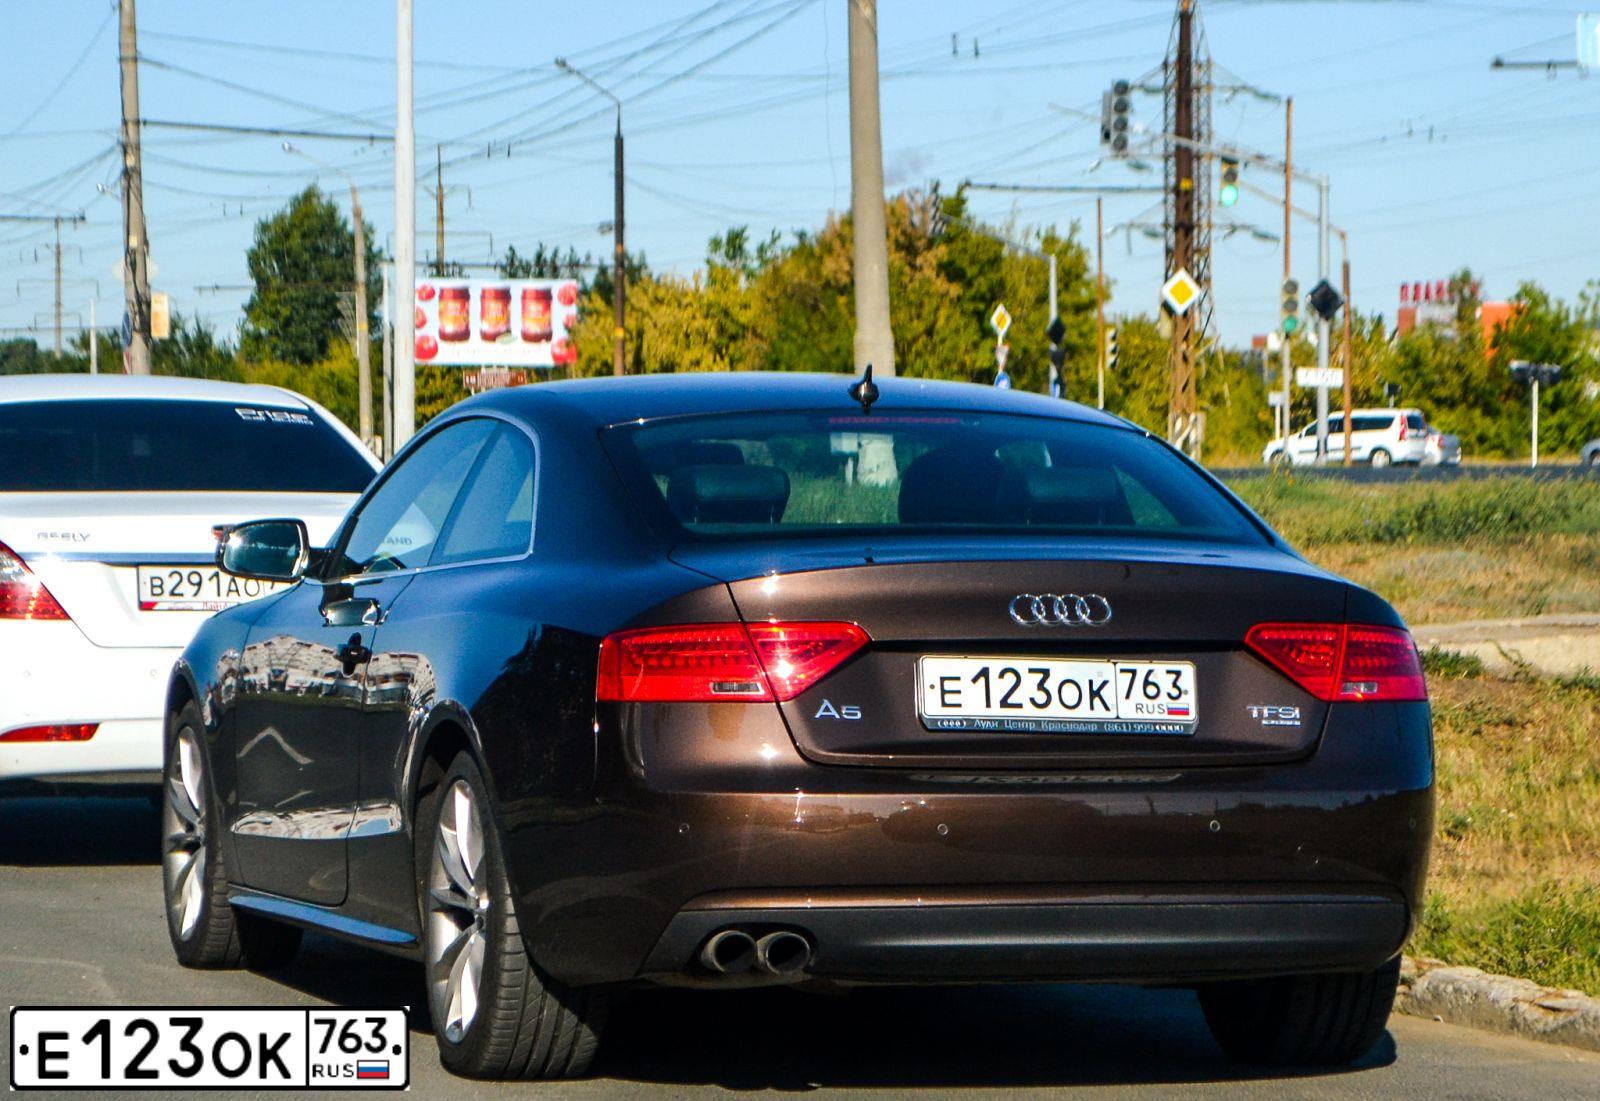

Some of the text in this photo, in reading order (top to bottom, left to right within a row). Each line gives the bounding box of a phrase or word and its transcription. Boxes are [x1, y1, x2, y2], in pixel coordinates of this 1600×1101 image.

[1119, 668, 1182, 701] 763
[814, 698, 862, 720] A5
[1135, 703, 1165, 715] RUS
[1246, 705, 1300, 719] TFSI
